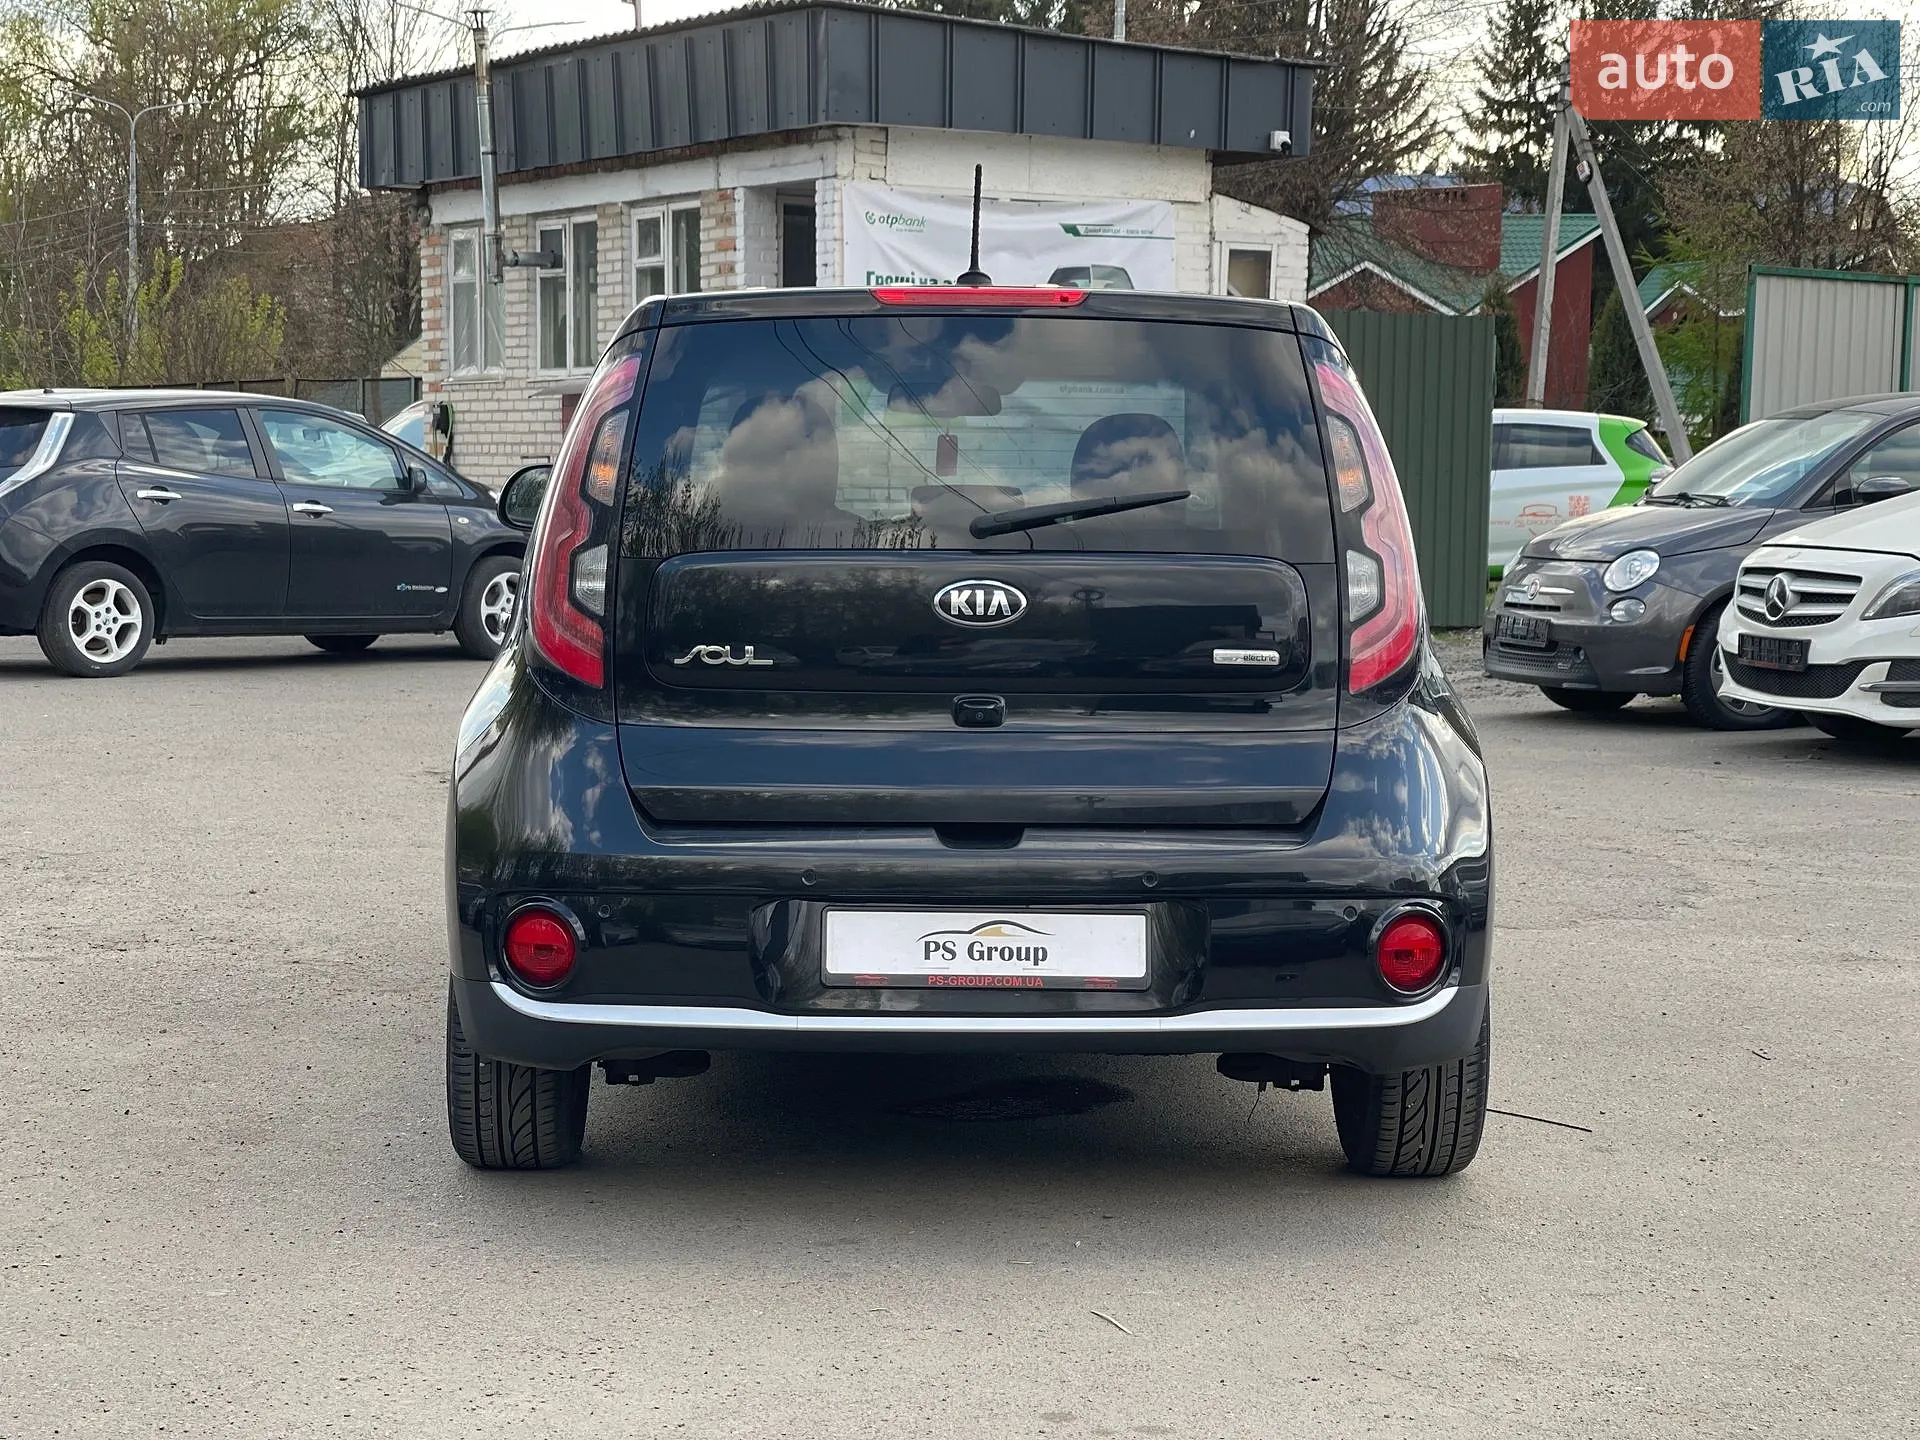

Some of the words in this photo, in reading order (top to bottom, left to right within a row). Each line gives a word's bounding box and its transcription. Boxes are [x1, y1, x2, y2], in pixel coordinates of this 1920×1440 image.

[878, 213, 926, 228] otpbank
[949, 589, 1012, 616] KIA
[673, 644, 774, 665] SOUL
[1243, 653, 1277, 662] electric
[924, 940, 957, 961] PS
[967, 940, 1048, 966] Group
[927, 975, 1044, 987] PS-GROUP.COM.UA
